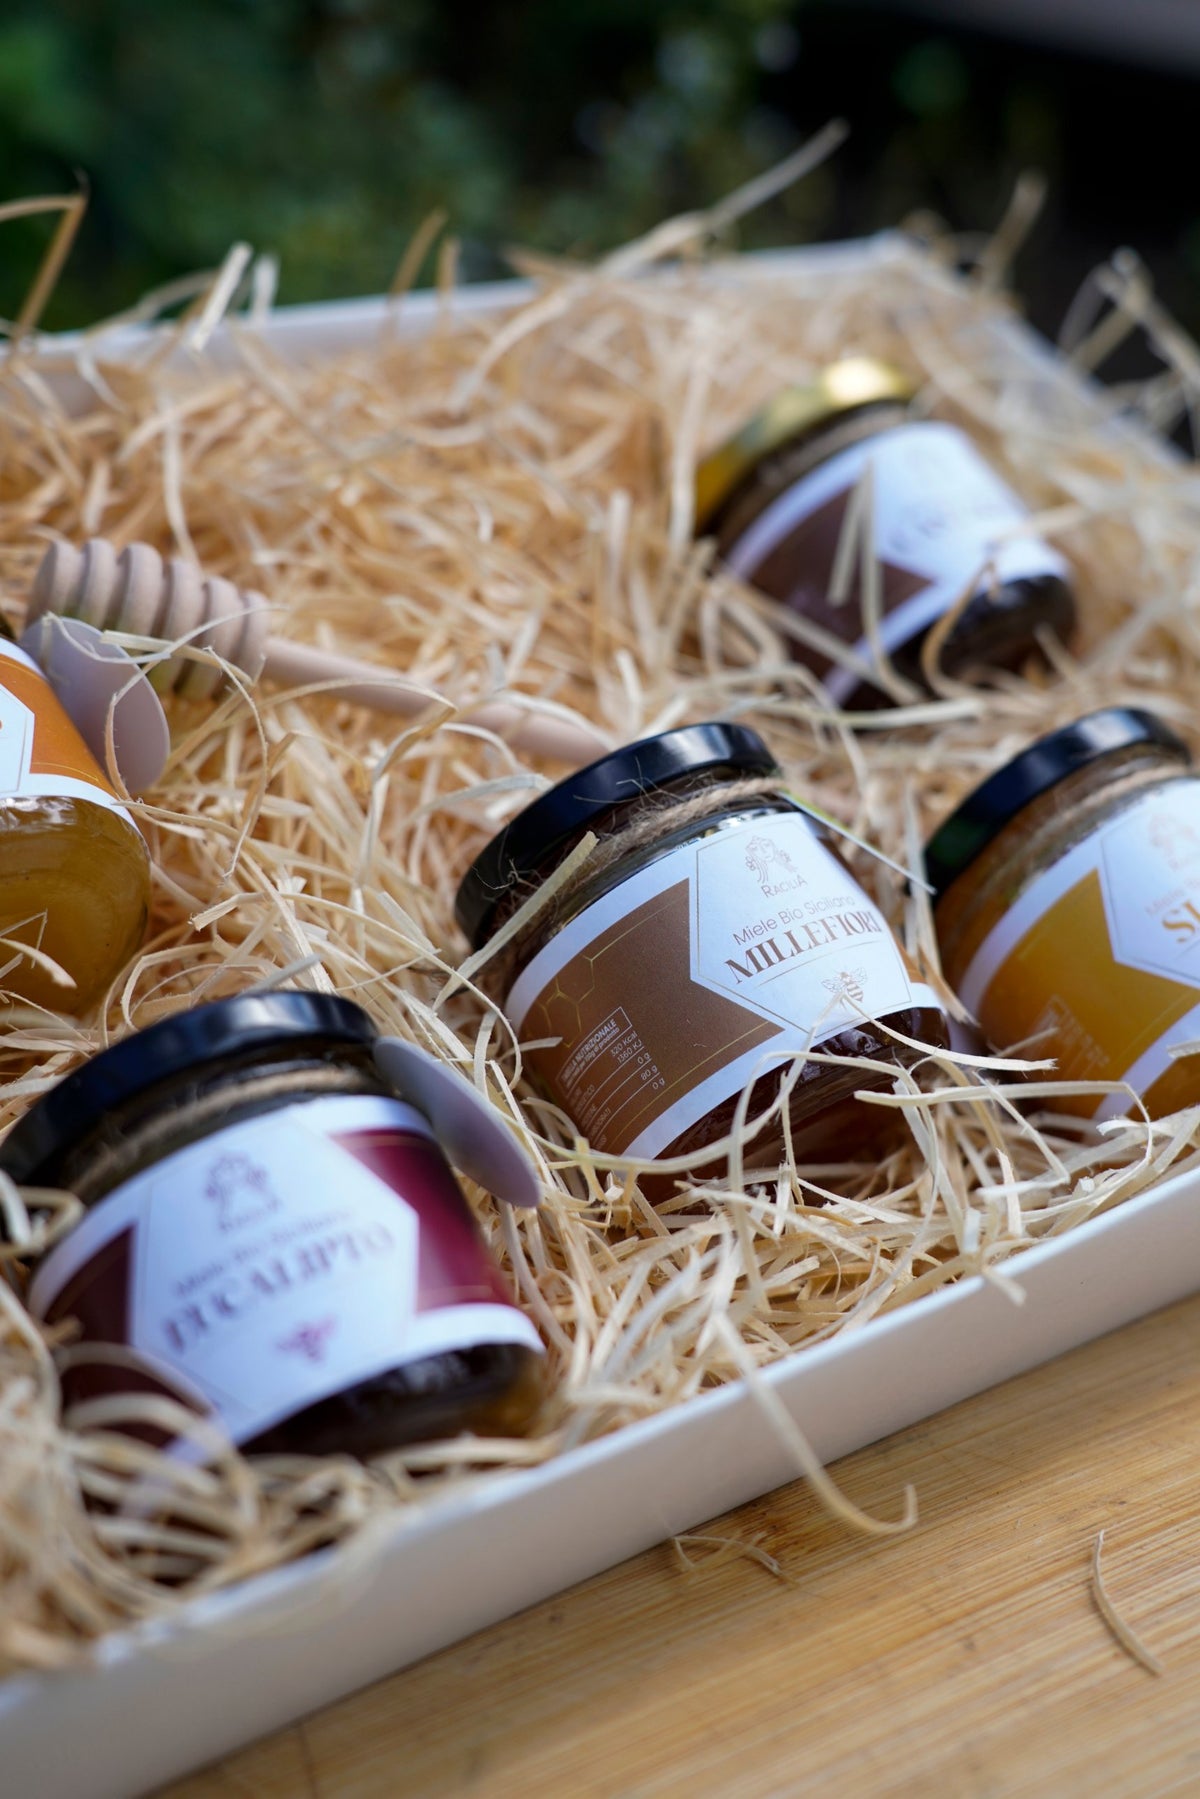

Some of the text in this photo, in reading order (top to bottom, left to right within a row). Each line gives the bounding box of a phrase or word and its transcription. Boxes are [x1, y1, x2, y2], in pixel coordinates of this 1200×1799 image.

[724, 910, 883, 985] MILLEFIORI
[732, 895, 857, 946] Miele Bio Siciliano
